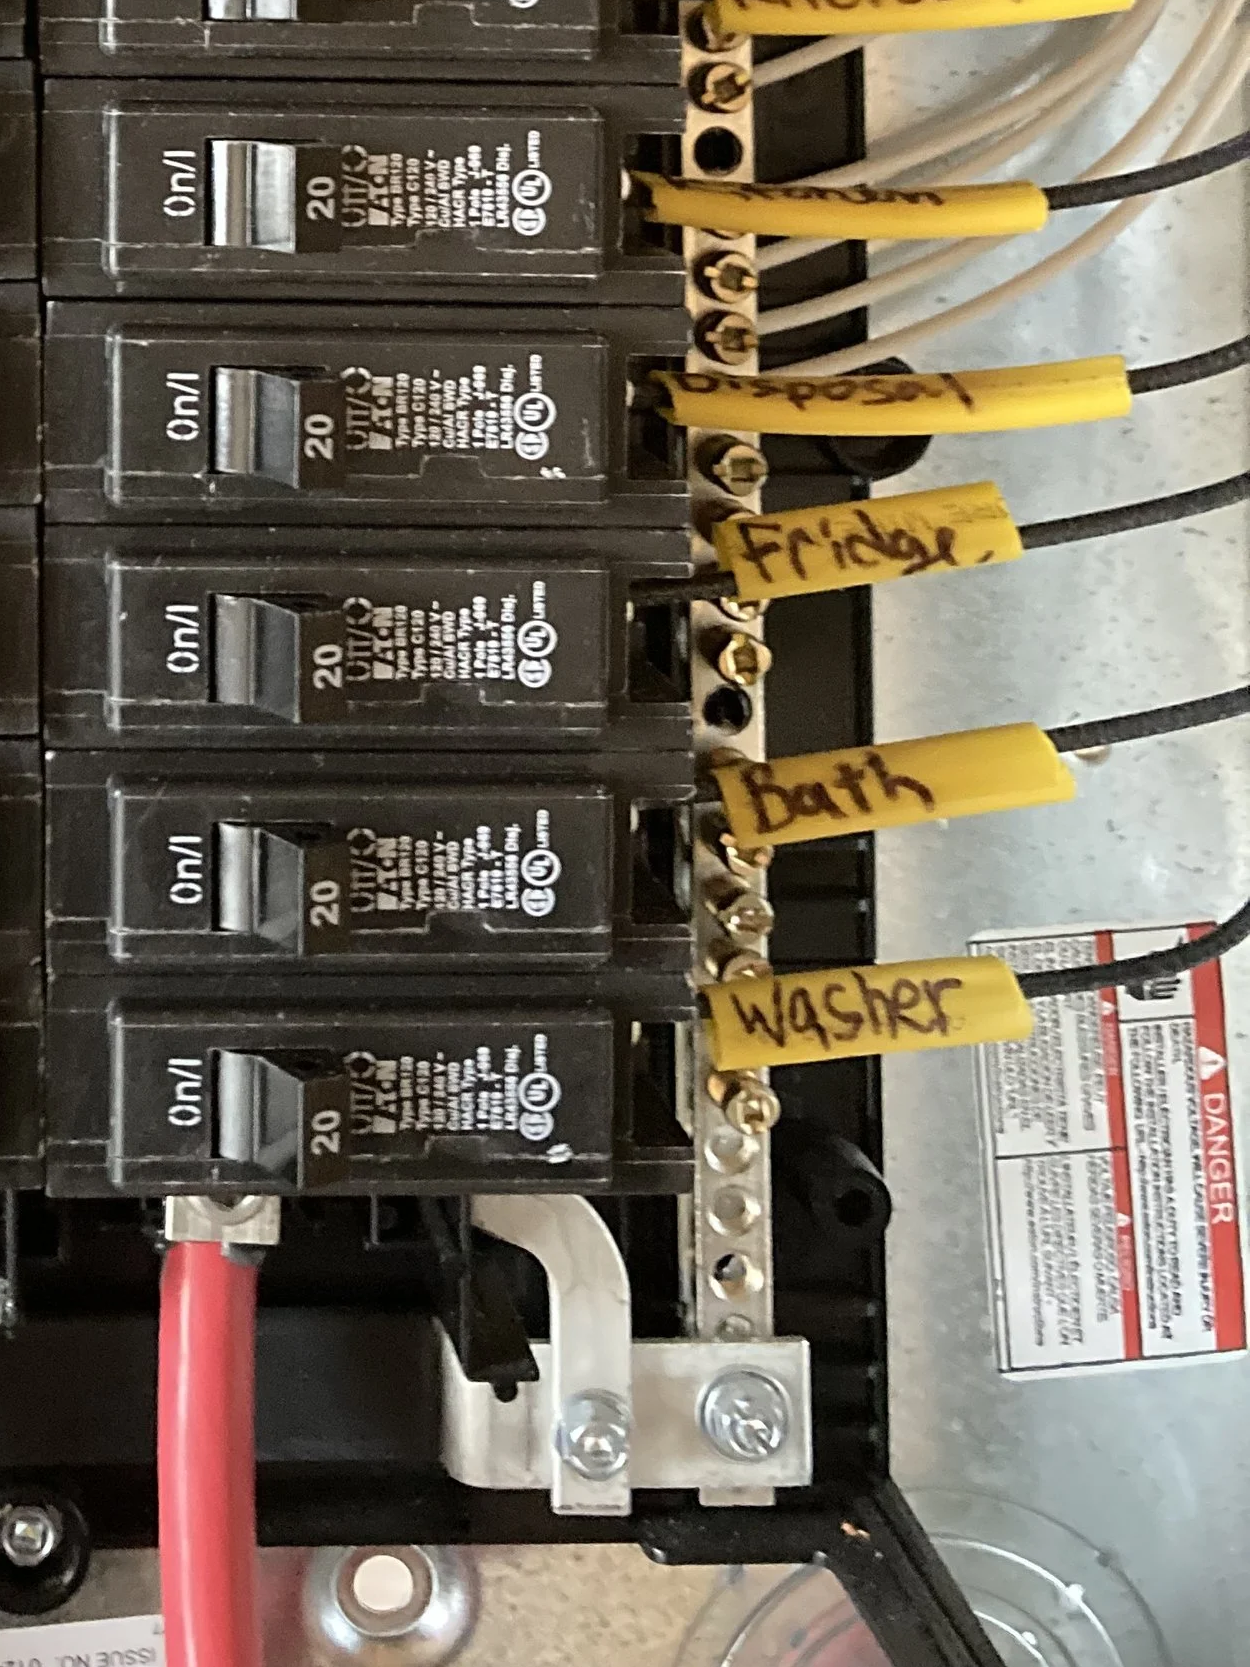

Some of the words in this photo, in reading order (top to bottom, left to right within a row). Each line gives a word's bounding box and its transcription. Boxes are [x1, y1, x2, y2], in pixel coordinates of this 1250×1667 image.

[306, 177, 336, 221] 20
[303, 414, 335, 460] 20
[312, 644, 343, 689] 20
[742, 751, 936, 832] Bath
[309, 881, 340, 927] 20
[310, 1110, 341, 1155] 20
[1203, 1092, 1235, 1225] DANGER
